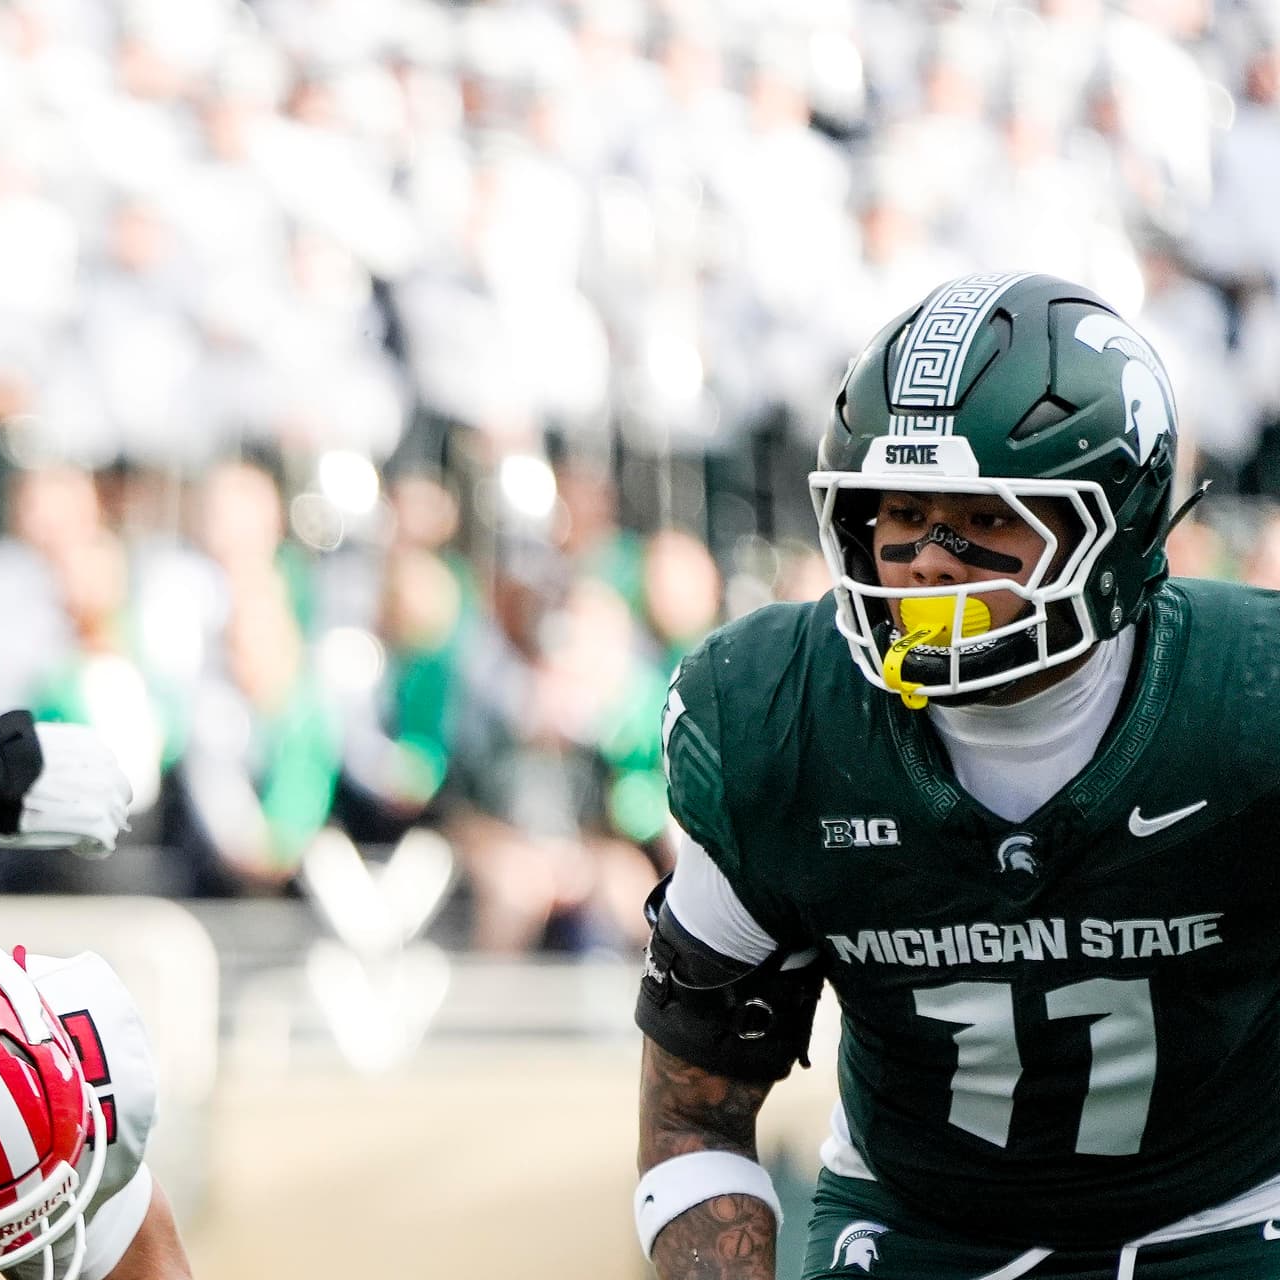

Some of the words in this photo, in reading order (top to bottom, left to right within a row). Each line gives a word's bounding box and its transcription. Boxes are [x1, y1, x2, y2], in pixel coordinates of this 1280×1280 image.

[885, 444, 940, 465] STATE
[825, 918, 1068, 968] MICHIGAN
[1080, 912, 1225, 961] STATE
[912, 977, 1158, 1157] 11
